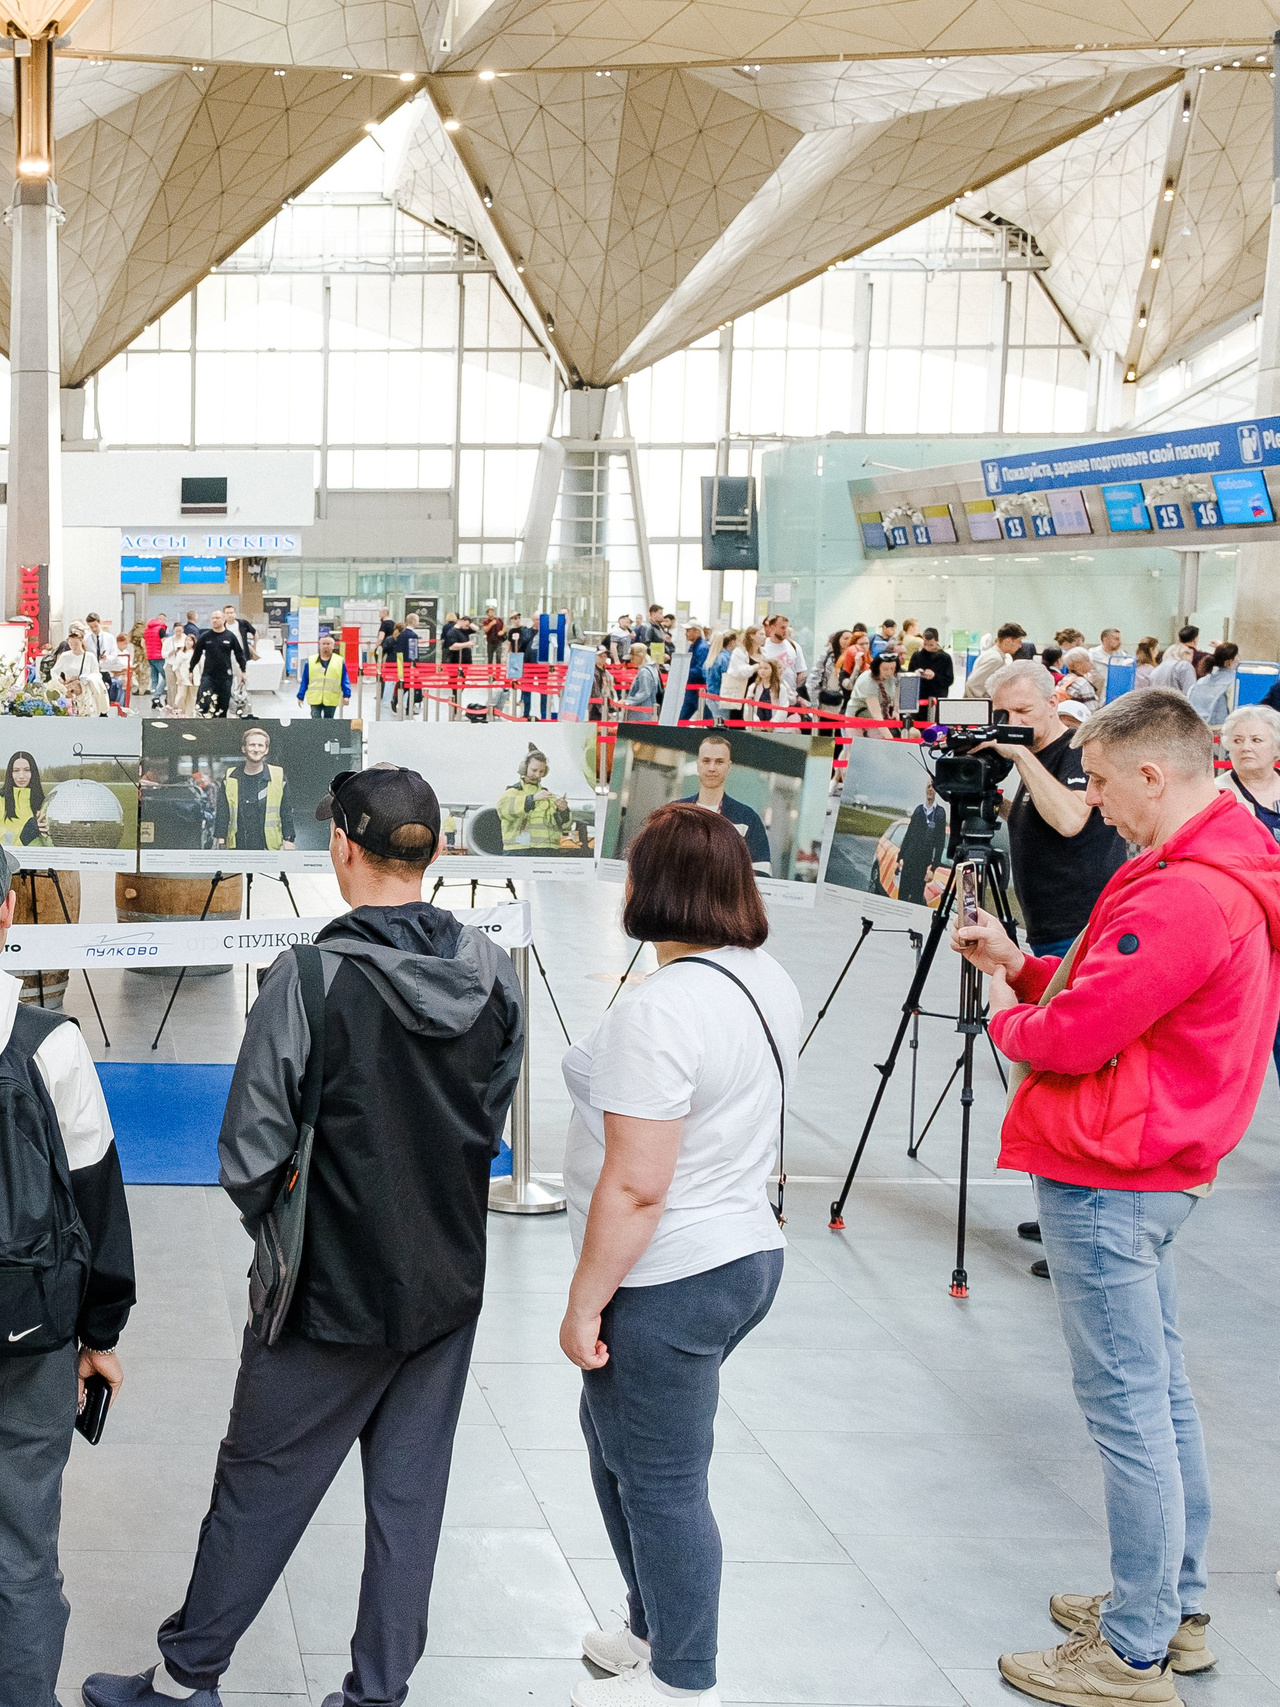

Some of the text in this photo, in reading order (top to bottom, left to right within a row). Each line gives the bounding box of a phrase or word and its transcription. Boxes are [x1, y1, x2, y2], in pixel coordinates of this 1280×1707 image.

[1090, 451, 1149, 473] подготовьте
[1149, 442, 1174, 464] свой
[1175, 441, 1220, 461] паспорт
[1160, 506, 1179, 528] 15
[1199, 503, 1218, 525] 16
[914, 526, 928, 543] 12
[1007, 518, 1023, 537] 13
[1037, 516, 1052, 536] 14
[121, 535, 188, 549] АССЫ
[204, 535, 296, 550] TICKETS
[893, 529, 907, 545] 11
[223, 935, 234, 949] С
[86, 946, 158, 957] ПУЛКОВО
